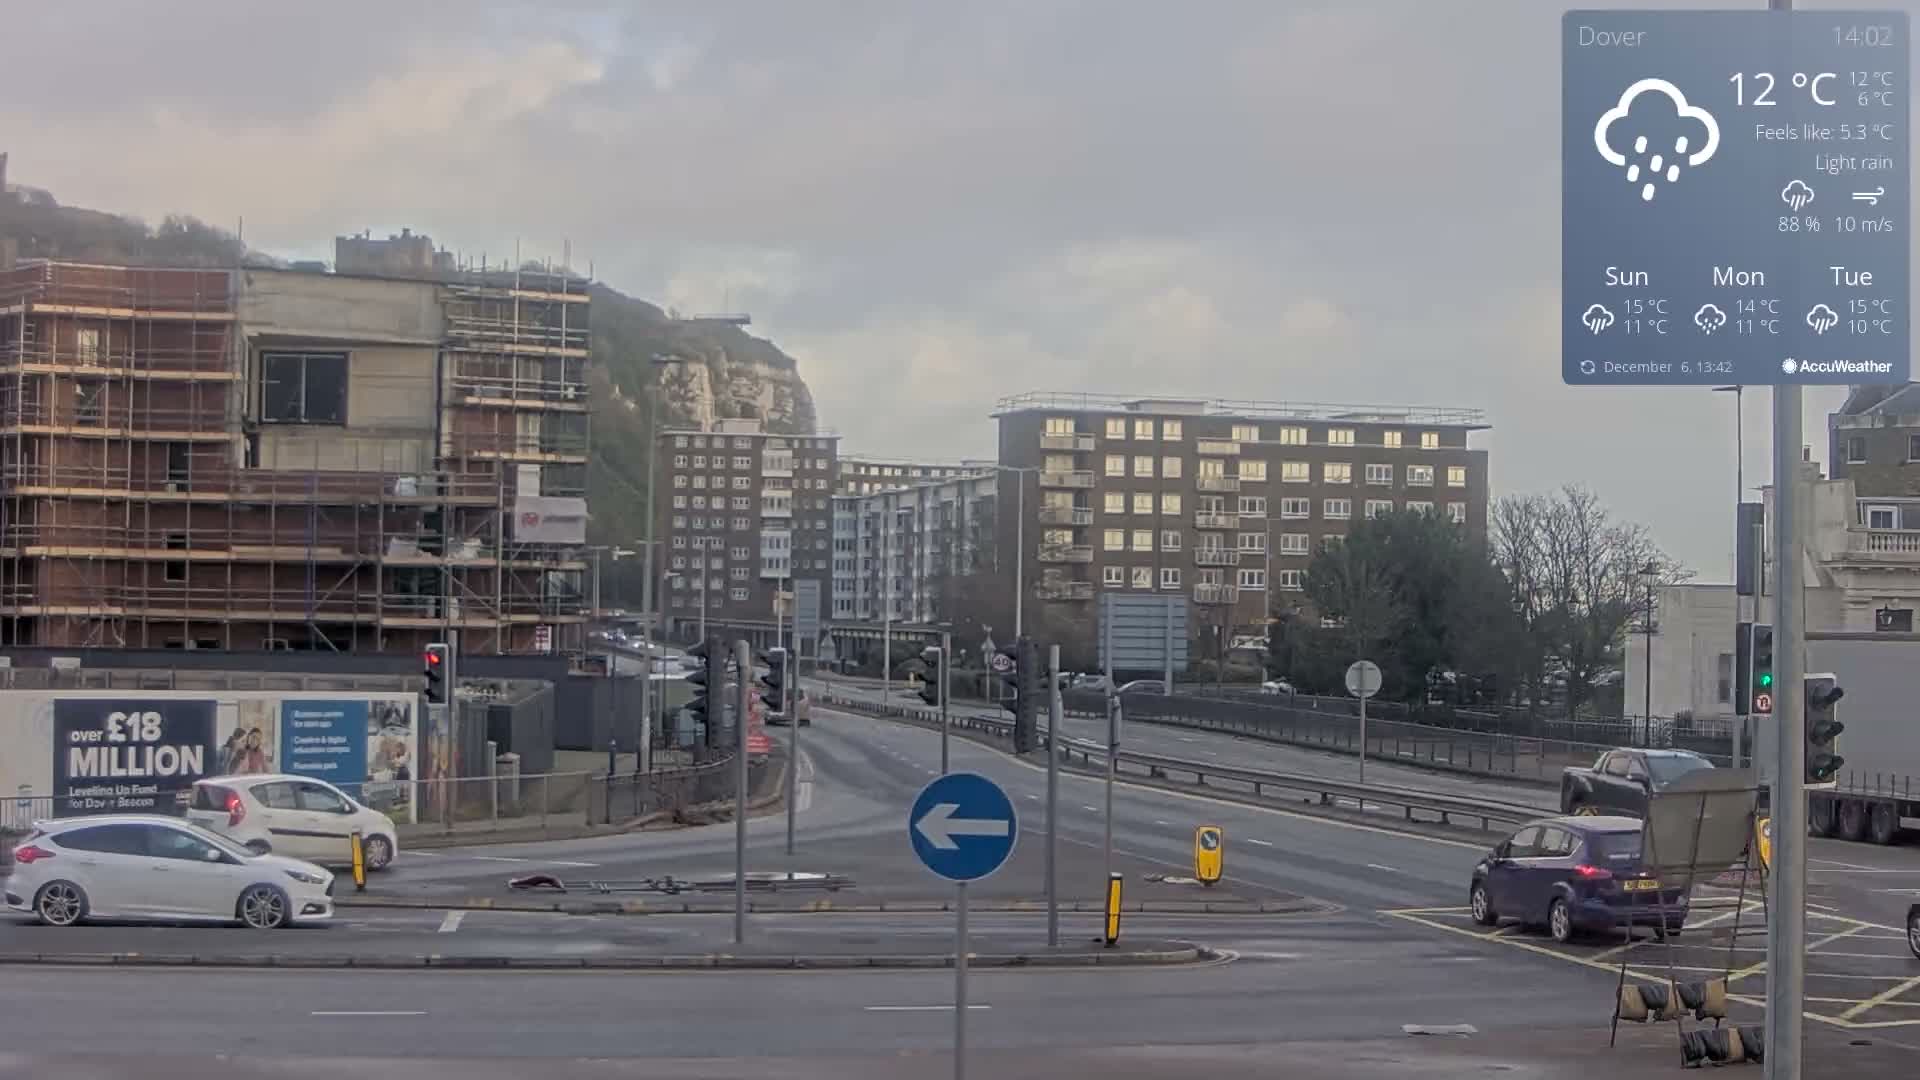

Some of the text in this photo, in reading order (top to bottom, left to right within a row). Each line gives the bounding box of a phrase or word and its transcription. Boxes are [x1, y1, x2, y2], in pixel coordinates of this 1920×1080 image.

[71, 712, 161, 741] over £18
[70, 745, 204, 777] MILLION
